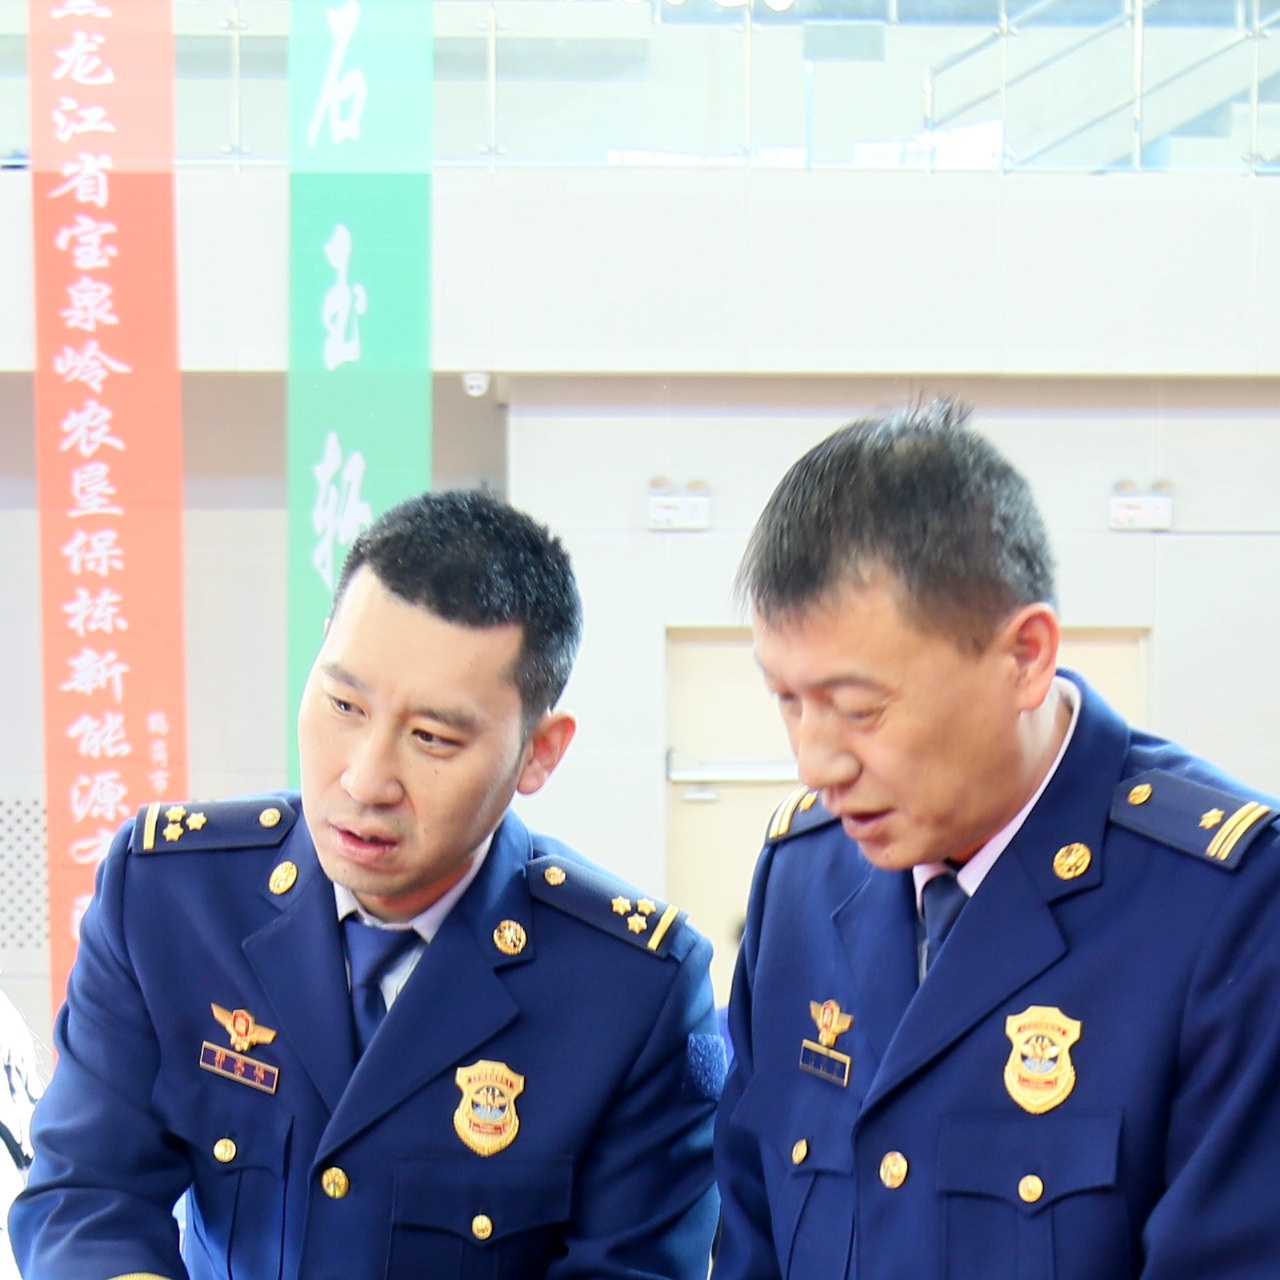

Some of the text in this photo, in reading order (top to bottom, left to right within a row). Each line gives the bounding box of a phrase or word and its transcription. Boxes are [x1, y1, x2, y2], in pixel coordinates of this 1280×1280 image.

[48, 0, 133, 865] 龙江省宝泉岭农垦保栋新能源
